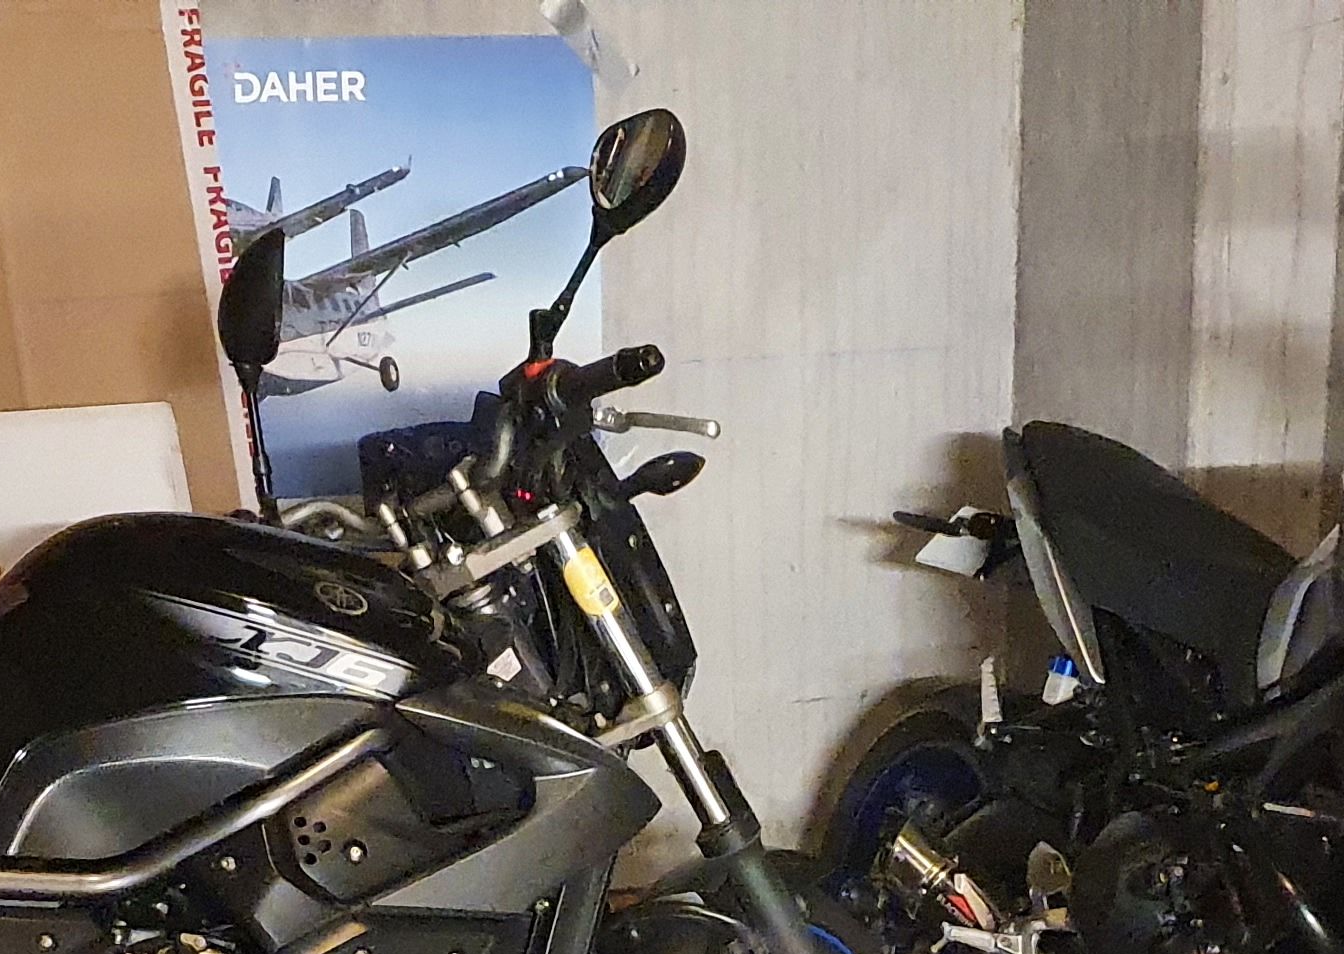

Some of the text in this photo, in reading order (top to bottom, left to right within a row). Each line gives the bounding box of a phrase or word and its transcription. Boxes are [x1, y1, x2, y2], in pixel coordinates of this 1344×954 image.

[178, 8, 234, 284] FRAGILE FRAGIL
[234, 70, 366, 103] DAHER
